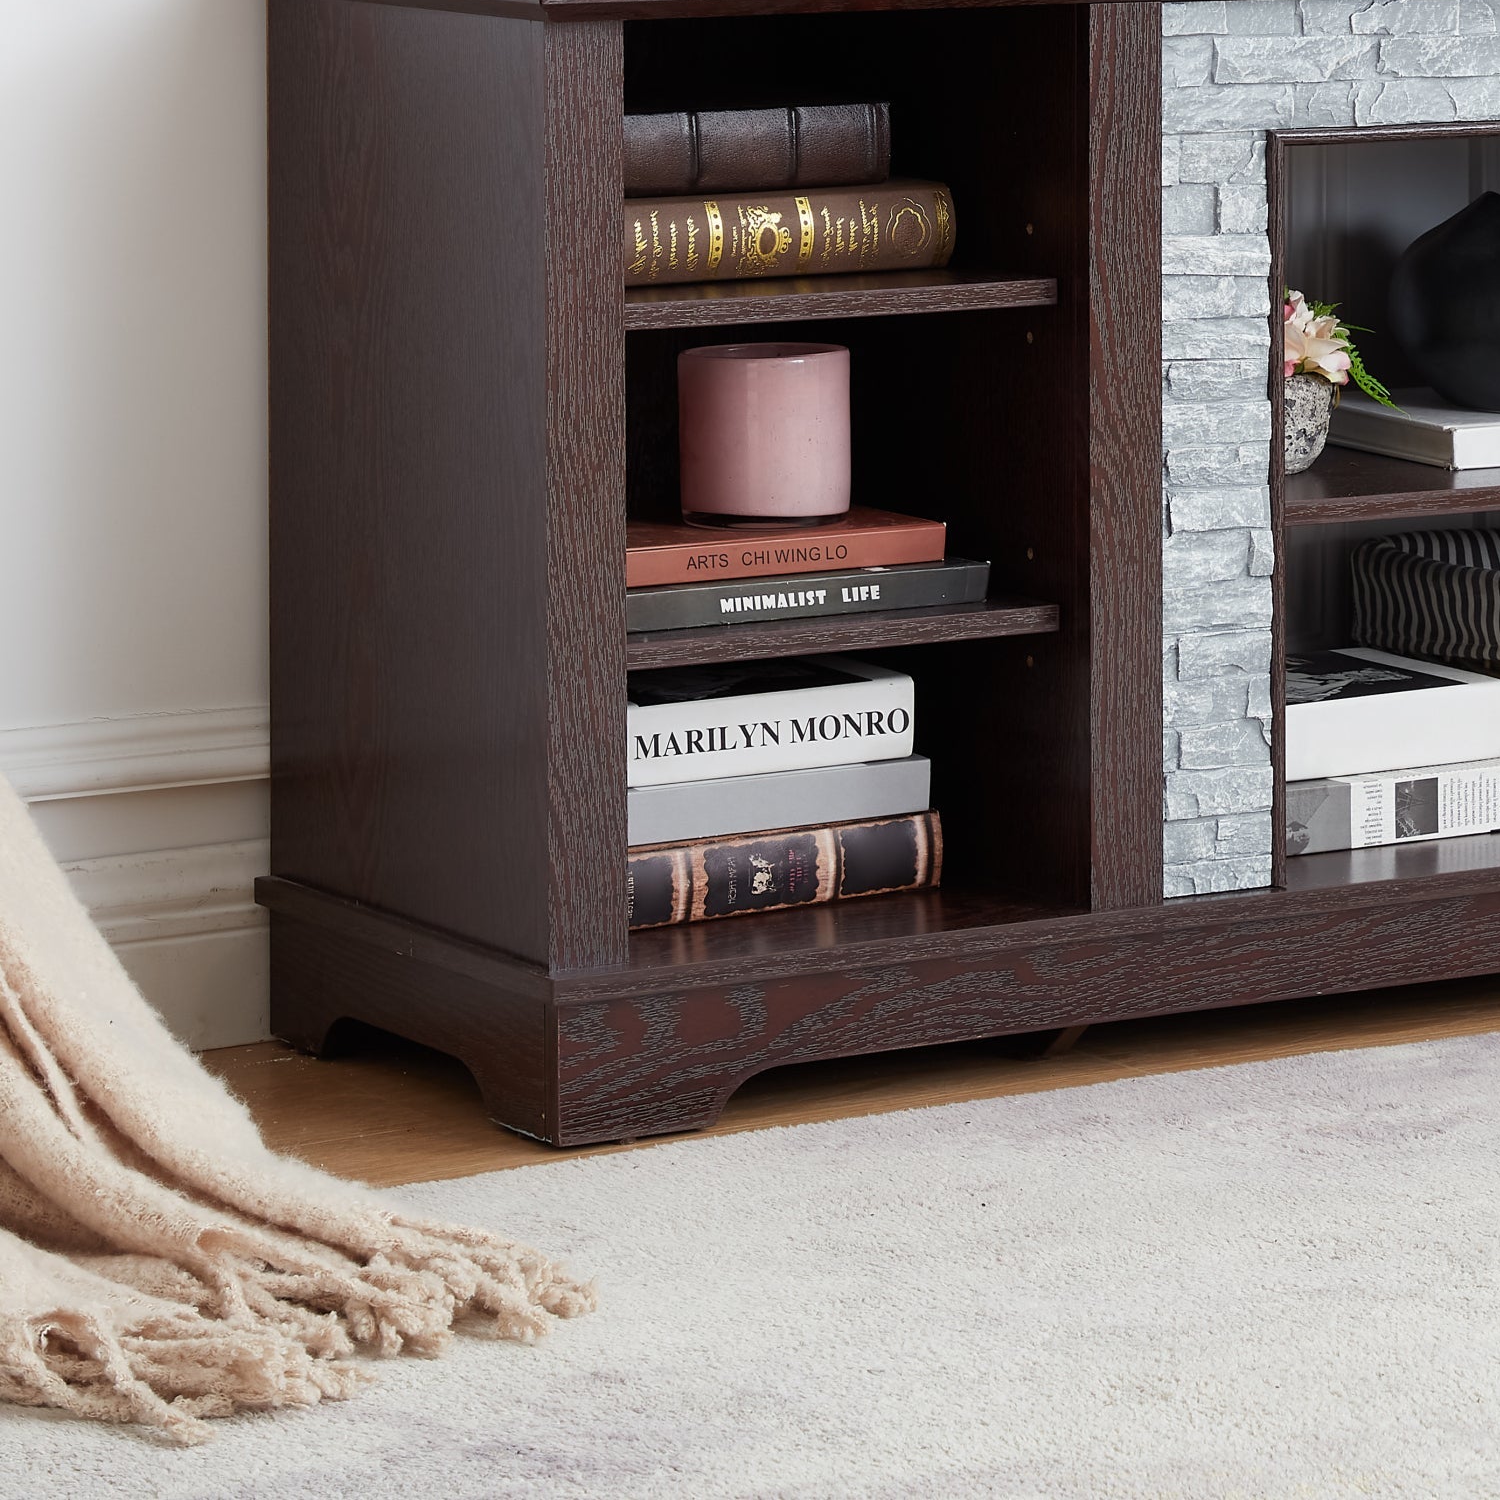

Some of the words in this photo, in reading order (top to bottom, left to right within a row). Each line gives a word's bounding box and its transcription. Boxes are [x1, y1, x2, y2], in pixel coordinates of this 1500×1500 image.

[686, 553, 729, 571] ARTS
[741, 551, 770, 566] CHI
[774, 546, 821, 564] WING
[825, 544, 848, 560] LO
[719, 590, 827, 614] MINIMALIST
[841, 584, 881, 603] LIFE
[633, 720, 781, 761] MARILYN
[789, 707, 910, 744] MONRO
